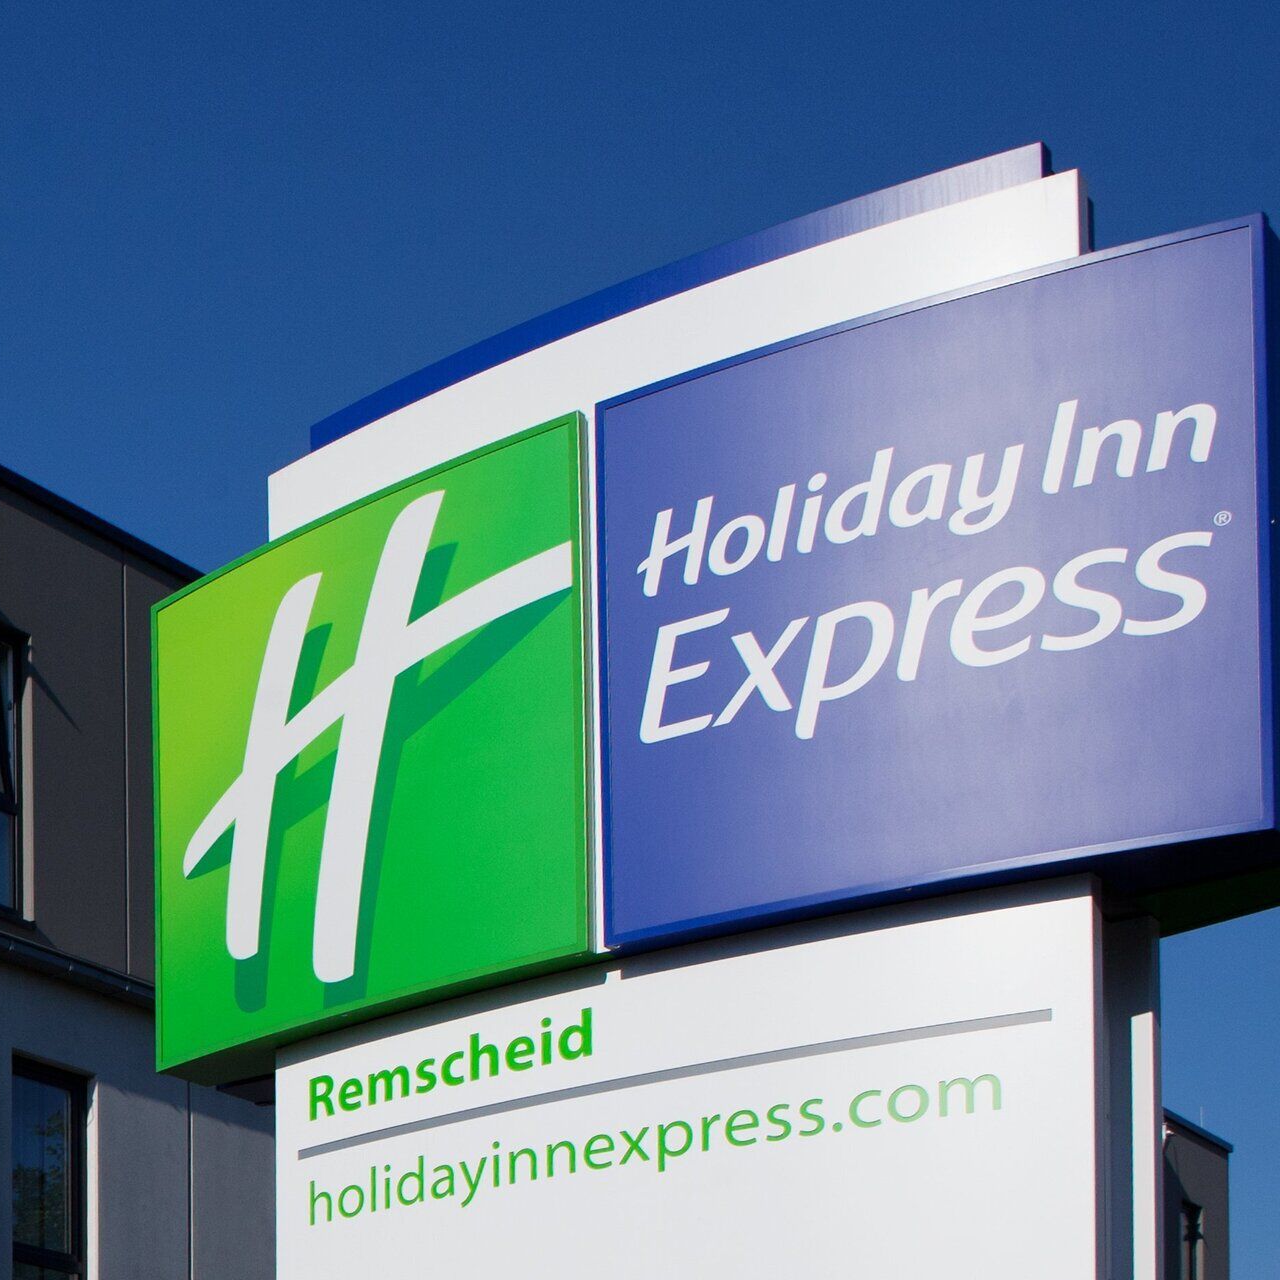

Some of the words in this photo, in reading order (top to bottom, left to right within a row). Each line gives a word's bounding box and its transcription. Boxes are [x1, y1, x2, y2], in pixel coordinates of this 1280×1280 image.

[637, 443, 1024, 598] Holiday
[1041, 398, 1218, 495] Inn
[308, 1007, 594, 1121] Remscheid
[308, 1072, 1003, 1226] holidayinnexpress.com
